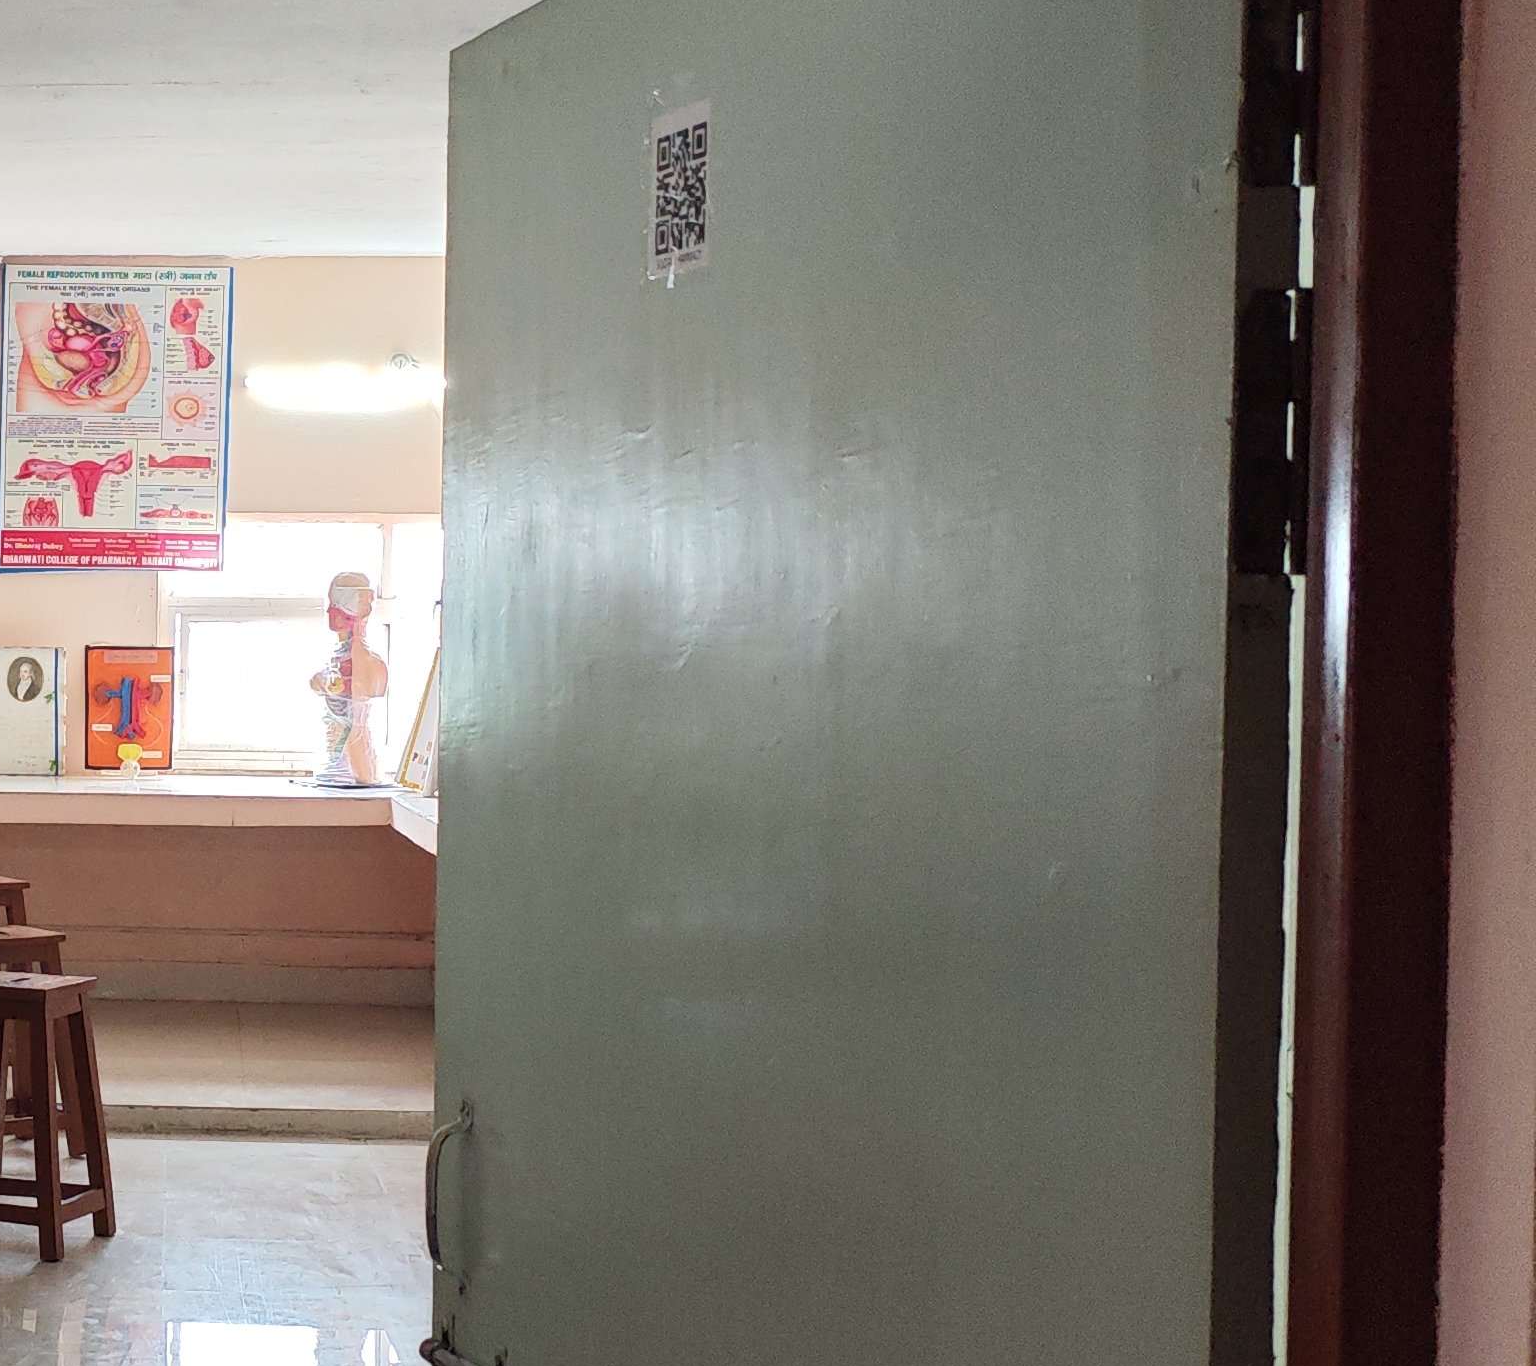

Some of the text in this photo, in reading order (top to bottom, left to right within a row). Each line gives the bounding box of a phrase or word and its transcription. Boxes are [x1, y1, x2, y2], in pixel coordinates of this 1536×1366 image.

[17, 270, 129, 279] FEMALE REPRODUCTIVE SYSTEM
[46, 555, 79, 565] COLLEGE
[80, 555, 91, 564] OF
